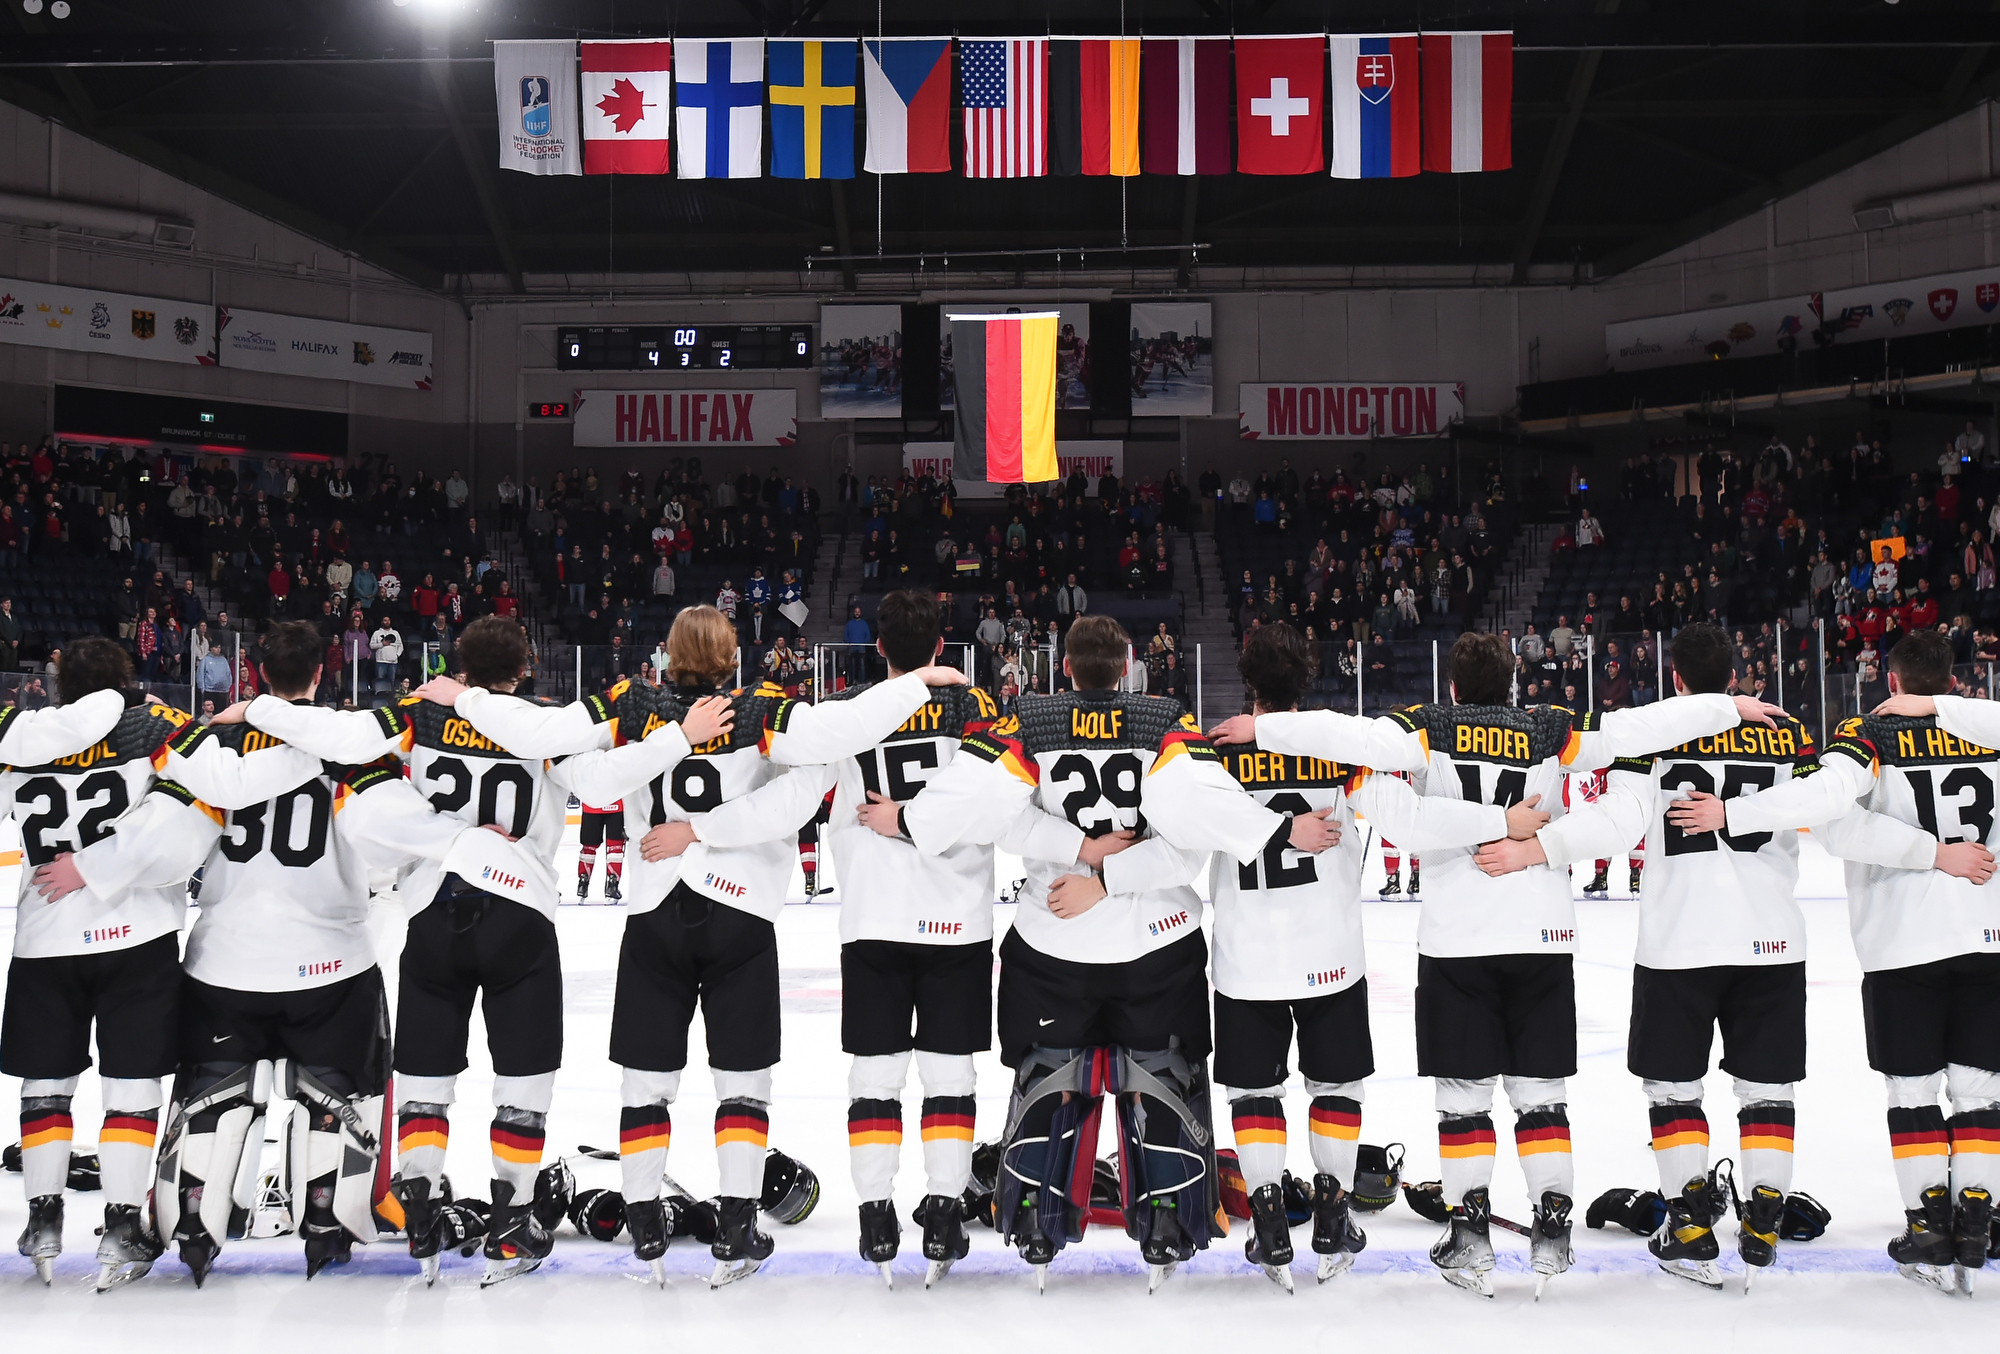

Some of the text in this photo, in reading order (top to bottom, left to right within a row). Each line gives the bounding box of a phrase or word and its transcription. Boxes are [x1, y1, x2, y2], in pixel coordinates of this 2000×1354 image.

[526, 120, 547, 131] IIHF
[513, 135, 564, 146] INTERNATIONAL
[513, 142, 565, 154] ICE HOCKEY
[519, 150, 561, 160] FEDERATION
[291, 340, 339, 356] HALIFAX
[570, 343, 580, 357] 0
[711, 340, 730, 348] GUEST
[797, 342, 807, 355] 0
[1619, 344, 1664, 358] Brunswick
[399, 351, 424, 362] HOCKEY
[648, 350, 659, 367] 4
[680, 352, 689, 366] 3
[719, 350, 731, 367] 2
[615, 394, 754, 442] HALIFAX
[1267, 386, 1437, 436] MONCTON
[161, 427, 201, 438] BRUNSWICK
[203, 431, 212, 439] ST
[217, 433, 235, 441] DUKE
[237, 434, 247, 442] ST
[1072, 707, 1124, 740] WOLF
[1456, 724, 1531, 760] BADER
[1898, 730, 1924, 758] N.
[1238, 752, 1286, 784] DER
[426, 755, 534, 839] 20
[1049, 752, 1148, 840] 29
[1903, 766, 1995, 845] 13
[15, 769, 129, 867] 22
[220, 777, 332, 868] 30
[492, 869, 526, 891] IIHF
[714, 876, 748, 898] IIHF
[928, 921, 962, 935] IIHF
[1158, 911, 1189, 932] IIHF
[94, 925, 132, 942] IIHF
[1550, 929, 1574, 943] IIHF
[1762, 940, 1787, 954] IIHF
[309, 959, 342, 976] IIHF
[1317, 967, 1347, 985] IIHF
